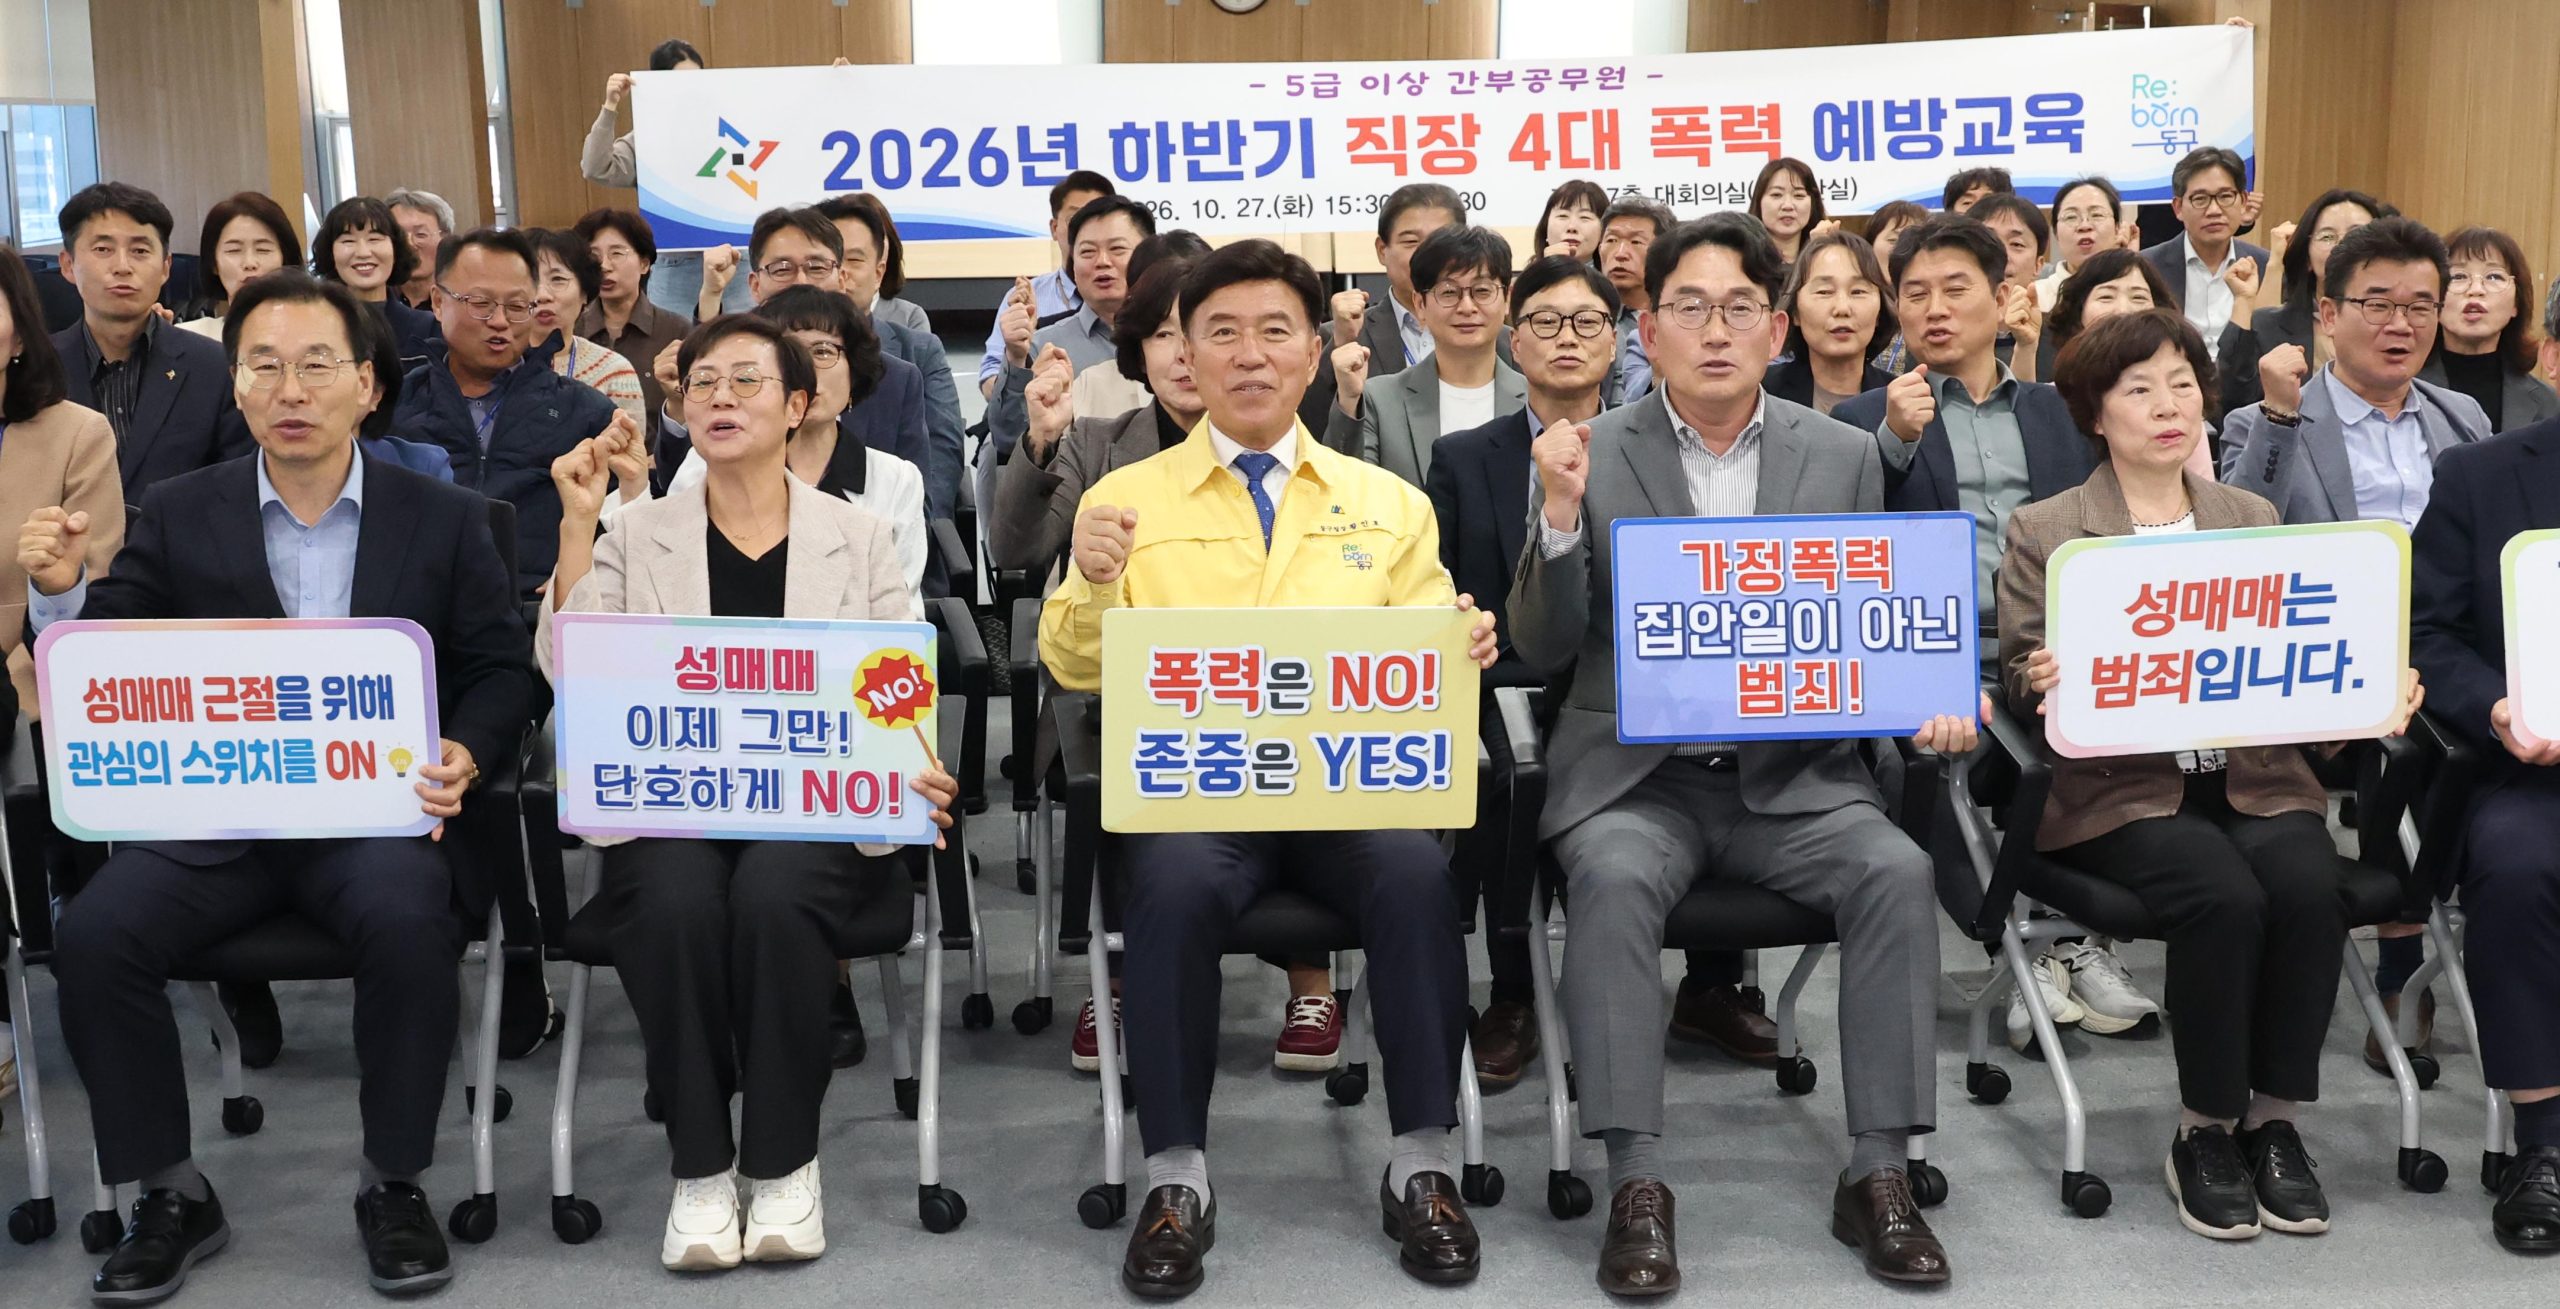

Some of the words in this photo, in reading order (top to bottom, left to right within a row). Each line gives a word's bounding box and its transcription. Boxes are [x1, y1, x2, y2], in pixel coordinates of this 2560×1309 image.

[1286, 73, 1341, 99] 5급
[1360, 72, 1430, 97] 이상
[1448, 66, 1627, 95] 간부공무원
[2131, 73, 2177, 99] Re:
[822, 123, 1078, 191] 2026년
[1109, 118, 1315, 183] 하반기
[1346, 112, 1482, 177] 직장
[1508, 107, 1621, 173] 4대
[1649, 102, 1782, 168] 폭력
[1813, 92, 2086, 163] 예방교육
[1145, 200, 1180, 220] 26.
[1192, 199, 1227, 220] 10.
[1236, 194, 1315, 219] 27.(화)
[1681, 539, 1890, 593] 가정폭력
[1635, 598, 1838, 657] 집안일이
[1860, 596, 1961, 652] 아닌
[2124, 573, 2338, 637] 성매매는
[675, 646, 815, 691] 성매매
[867, 667, 924, 713] NO!
[1149, 649, 1309, 713] 폭력은
[1332, 653, 1436, 707] NO!
[1739, 659, 1861, 715] 범죄!
[2091, 639, 2365, 709] 범죄입니다.
[83, 677, 194, 724] 성매매
[203, 675, 312, 722] 근절을
[322, 674, 395, 721] 위해
[626, 704, 717, 750] 이제
[740, 708, 850, 754] 그만!
[67, 739, 171, 786] 관심의
[181, 738, 318, 785] 스위치를
[325, 740, 377, 781] ON
[1135, 733, 1294, 793] 존중은
[1316, 734, 1447, 787] YES!
[594, 763, 780, 810] 단호하게
[802, 769, 900, 816] NO!
